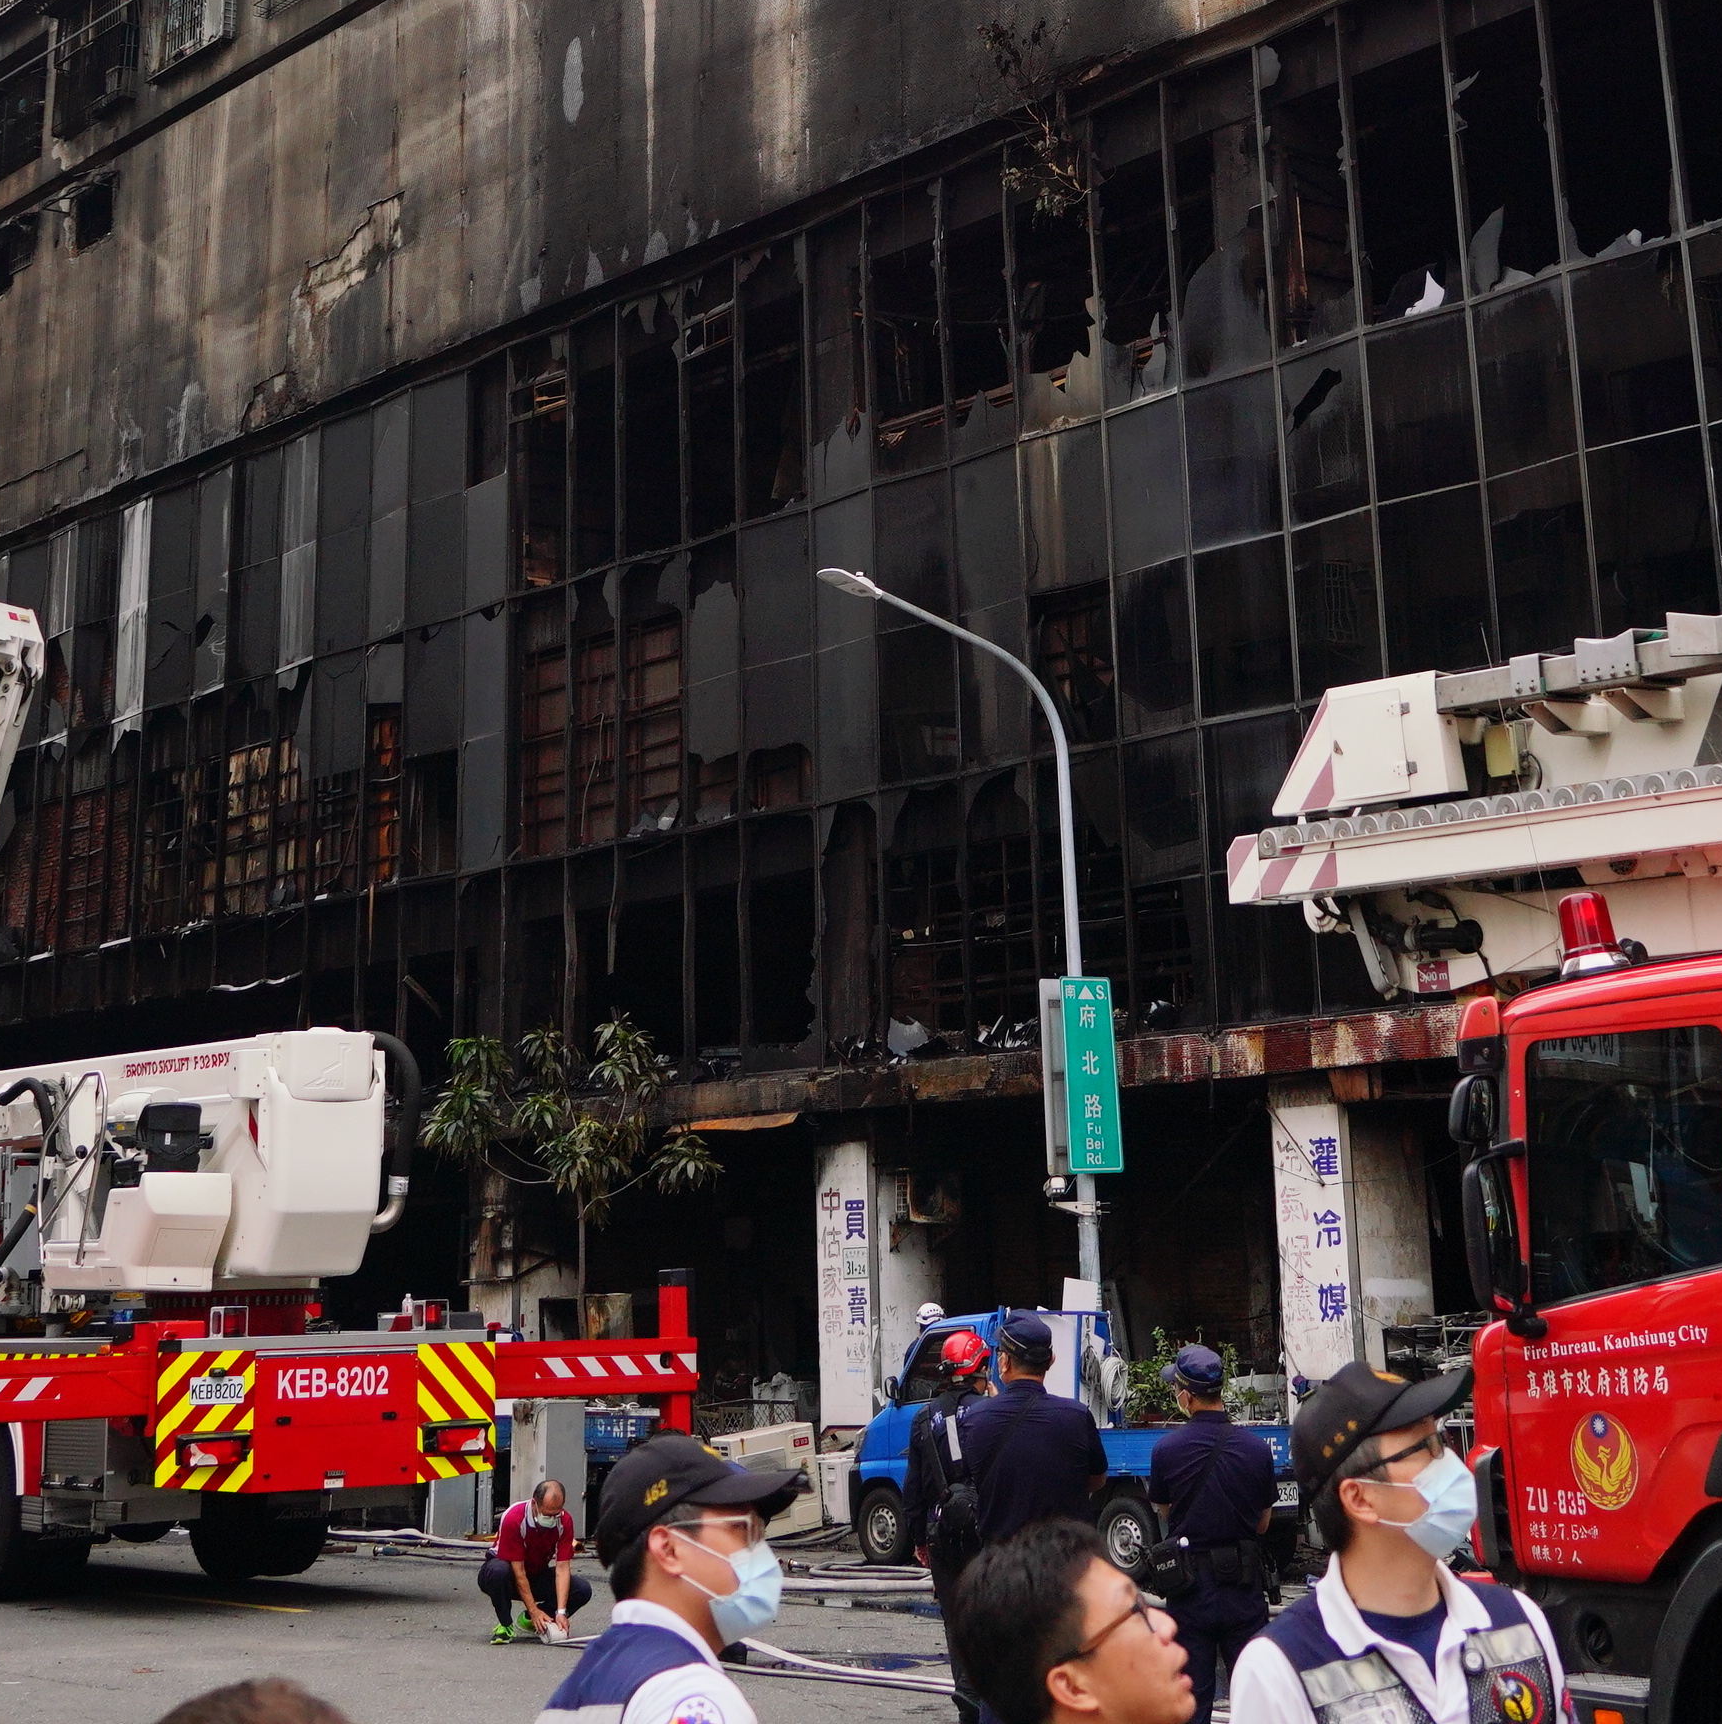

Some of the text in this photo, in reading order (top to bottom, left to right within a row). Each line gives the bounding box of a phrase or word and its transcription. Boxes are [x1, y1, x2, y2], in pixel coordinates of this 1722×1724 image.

[1064, 984, 1076, 999] 南
[1095, 984, 1108, 1000] S.
[125, 1061, 158, 1078] BRONTO
[158, 1057, 191, 1074] SKYLIFT
[1079, 1004, 1102, 1119] 府北路
[1087, 1122, 1102, 1135] Fu
[1086, 1137, 1105, 1151] Bei
[1086, 1152, 1106, 1165] Rd.
[1523, 1324, 1708, 1361] Fire Bureau, Kaohsiung City
[277, 1365, 389, 1400] KEB-8202
[1527, 1365, 1669, 1400] 高雄市政府消防局
[191, 1383, 243, 1400] KEB-8202
[643, 1479, 669, 1506] 462
[1156, 1558, 1177, 1572] POLICE
